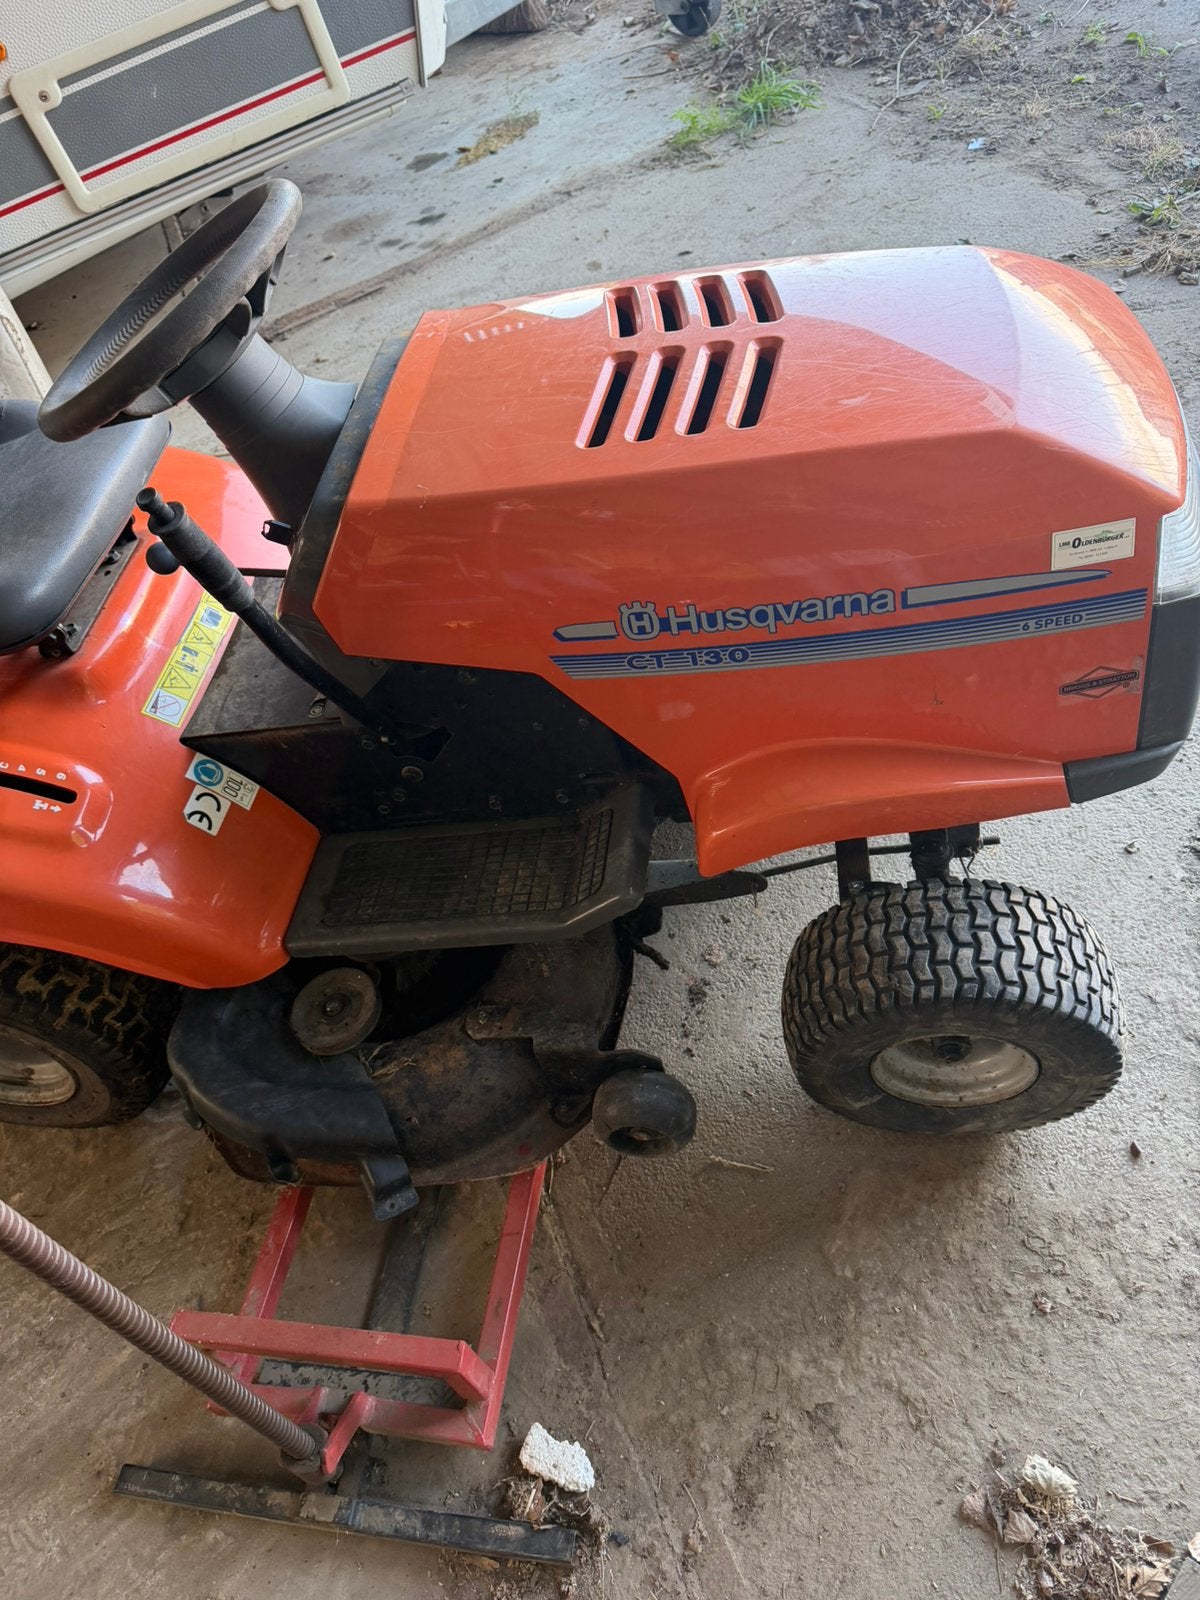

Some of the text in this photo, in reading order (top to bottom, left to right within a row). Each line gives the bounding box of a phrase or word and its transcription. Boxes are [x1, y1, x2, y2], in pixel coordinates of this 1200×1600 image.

[667, 588, 896, 636] Husqvarna
[1021, 613, 1084, 632] 6 SPEED
[686, 647, 751, 667] 130
[223, 776, 244, 798] 100
[186, 791, 222, 832] CE
